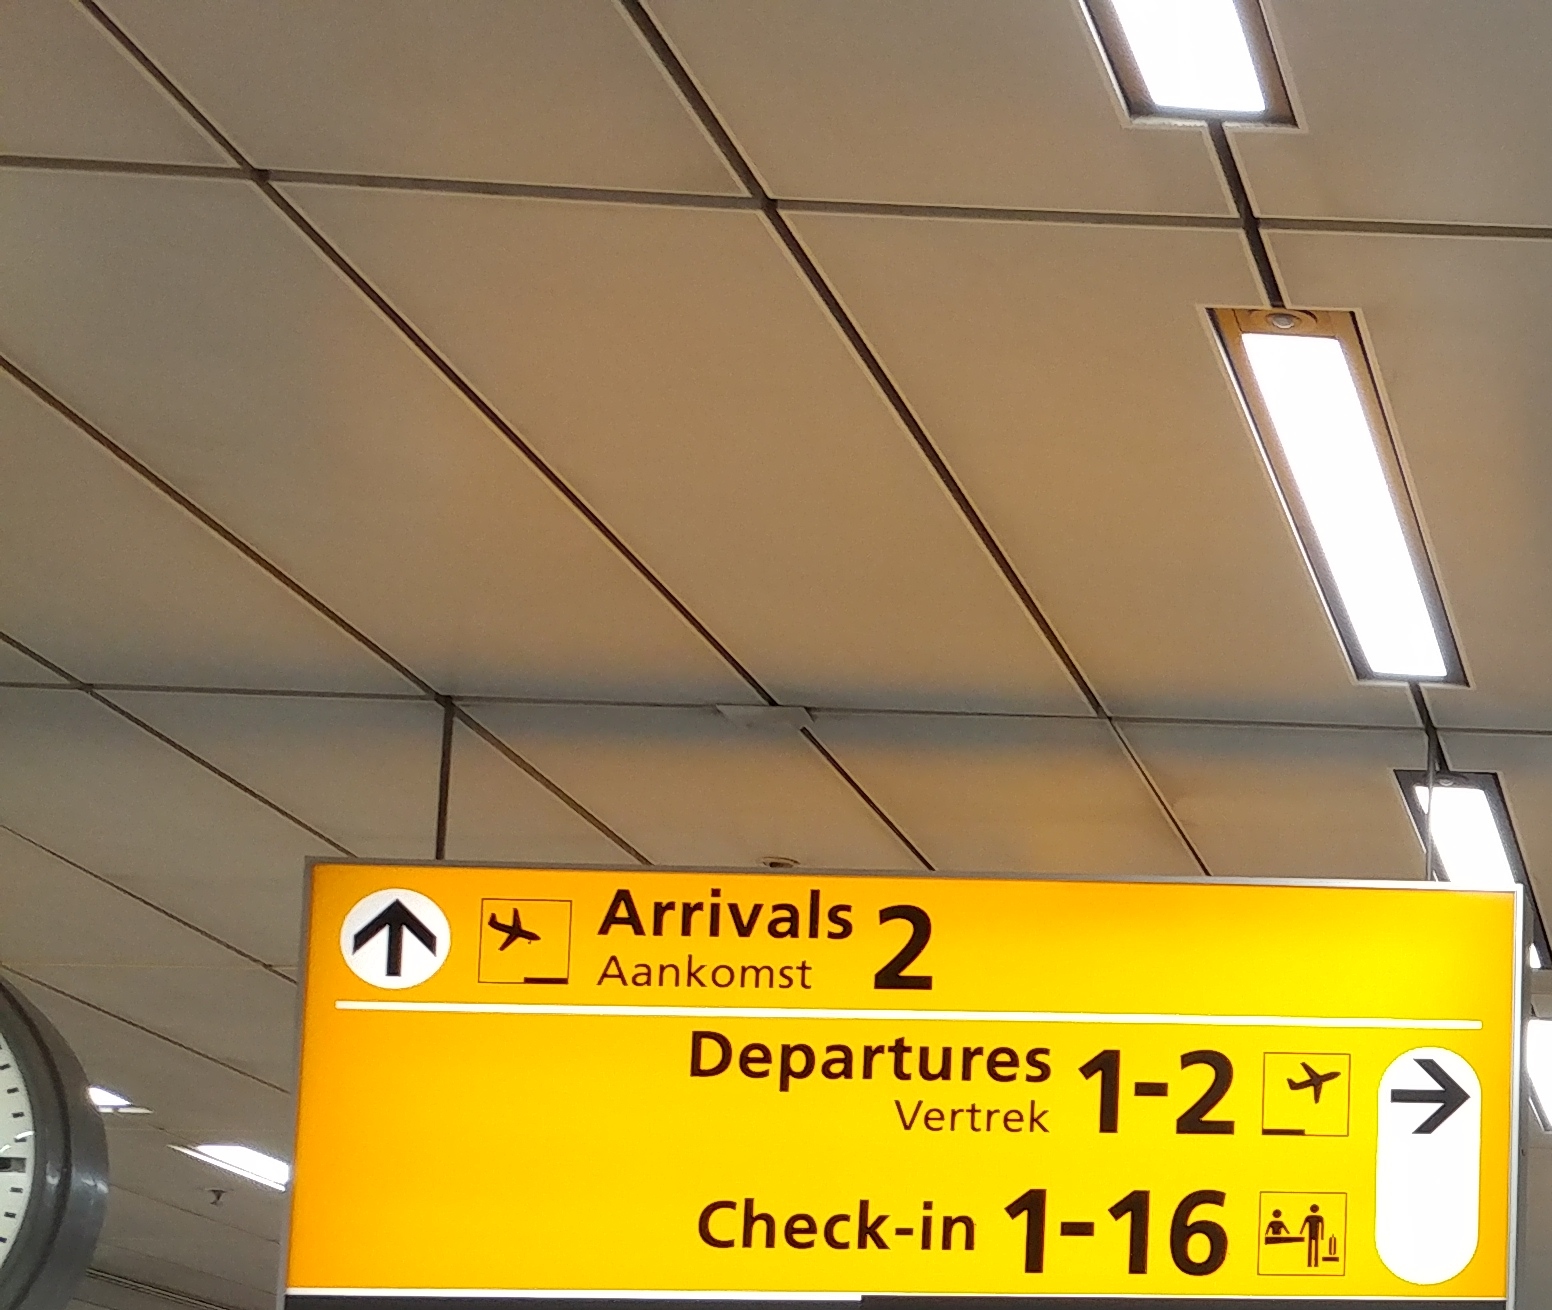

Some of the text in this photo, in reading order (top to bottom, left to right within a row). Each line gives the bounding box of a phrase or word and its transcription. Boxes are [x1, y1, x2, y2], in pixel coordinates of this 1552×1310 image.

[597, 954, 812, 990] Aankomst
[598, 888, 932, 990] Arrivals 2
[689, 1030, 1235, 1135] Departures 1-2
[894, 1099, 1050, 1133] Vertrek
[698, 1188, 1229, 1277] Check-in 1-16
